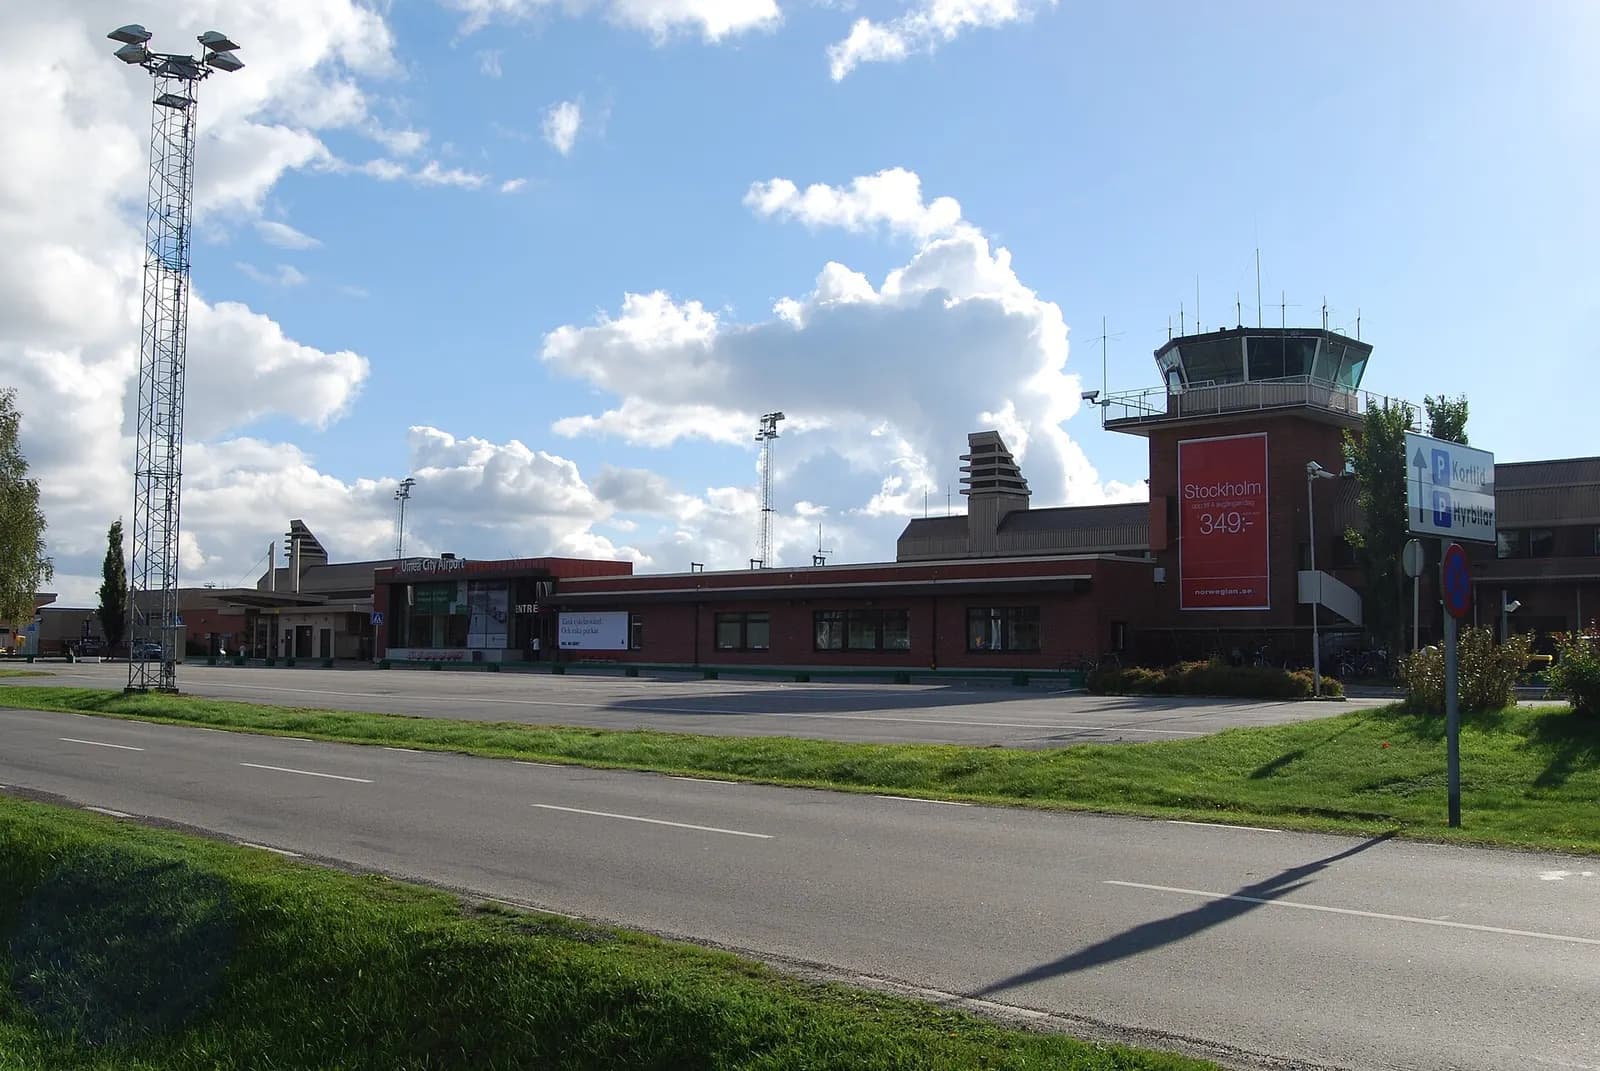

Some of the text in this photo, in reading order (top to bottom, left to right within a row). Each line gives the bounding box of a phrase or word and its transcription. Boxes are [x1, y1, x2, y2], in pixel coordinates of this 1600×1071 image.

[1184, 480, 1261, 500] Stockholm
[1453, 501, 1493, 527] Hyrbilar
[422, 558, 436, 575] City
[437, 559, 464, 573] Airport
[1194, 587, 1253, 596] norwegian.se
